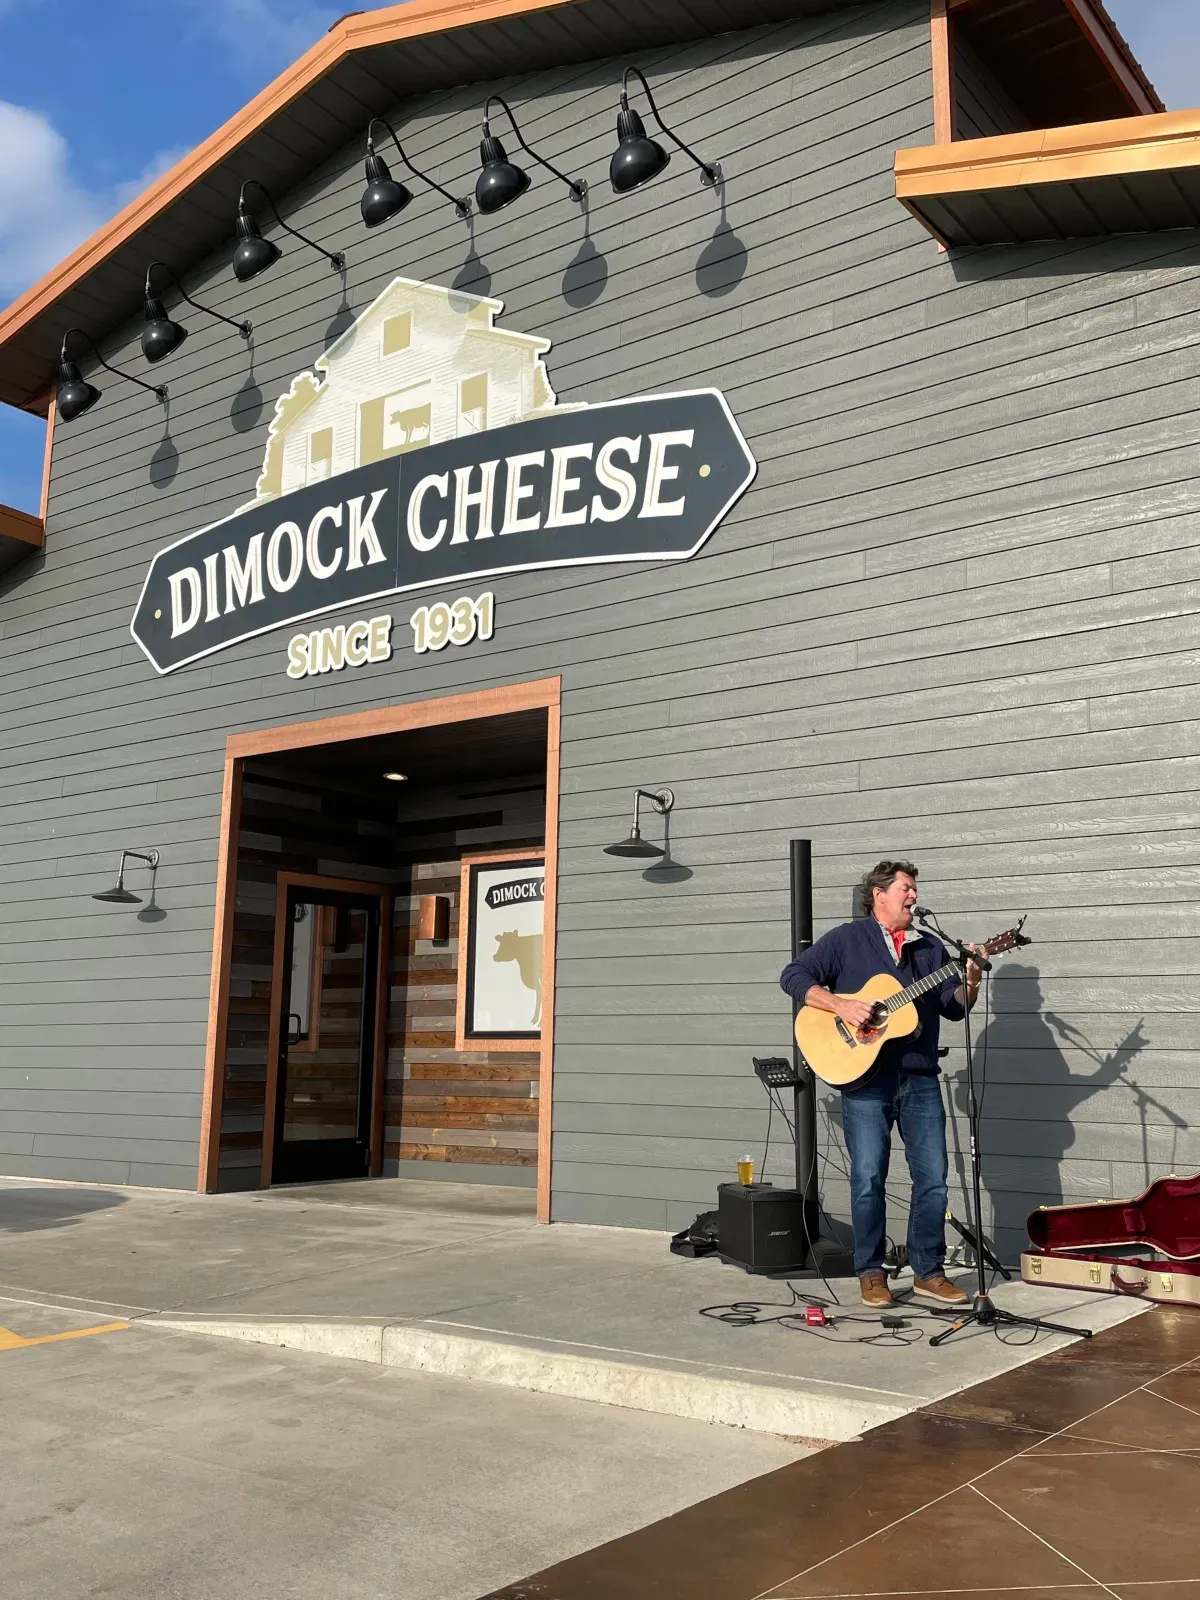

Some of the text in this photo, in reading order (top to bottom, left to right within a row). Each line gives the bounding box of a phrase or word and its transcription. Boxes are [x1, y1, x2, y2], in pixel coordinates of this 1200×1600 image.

[168, 429, 695, 639] DIMOCK CHEESE
[287, 591, 494, 679] SINCE 1931
[492, 882, 537, 904] DIMOCK
